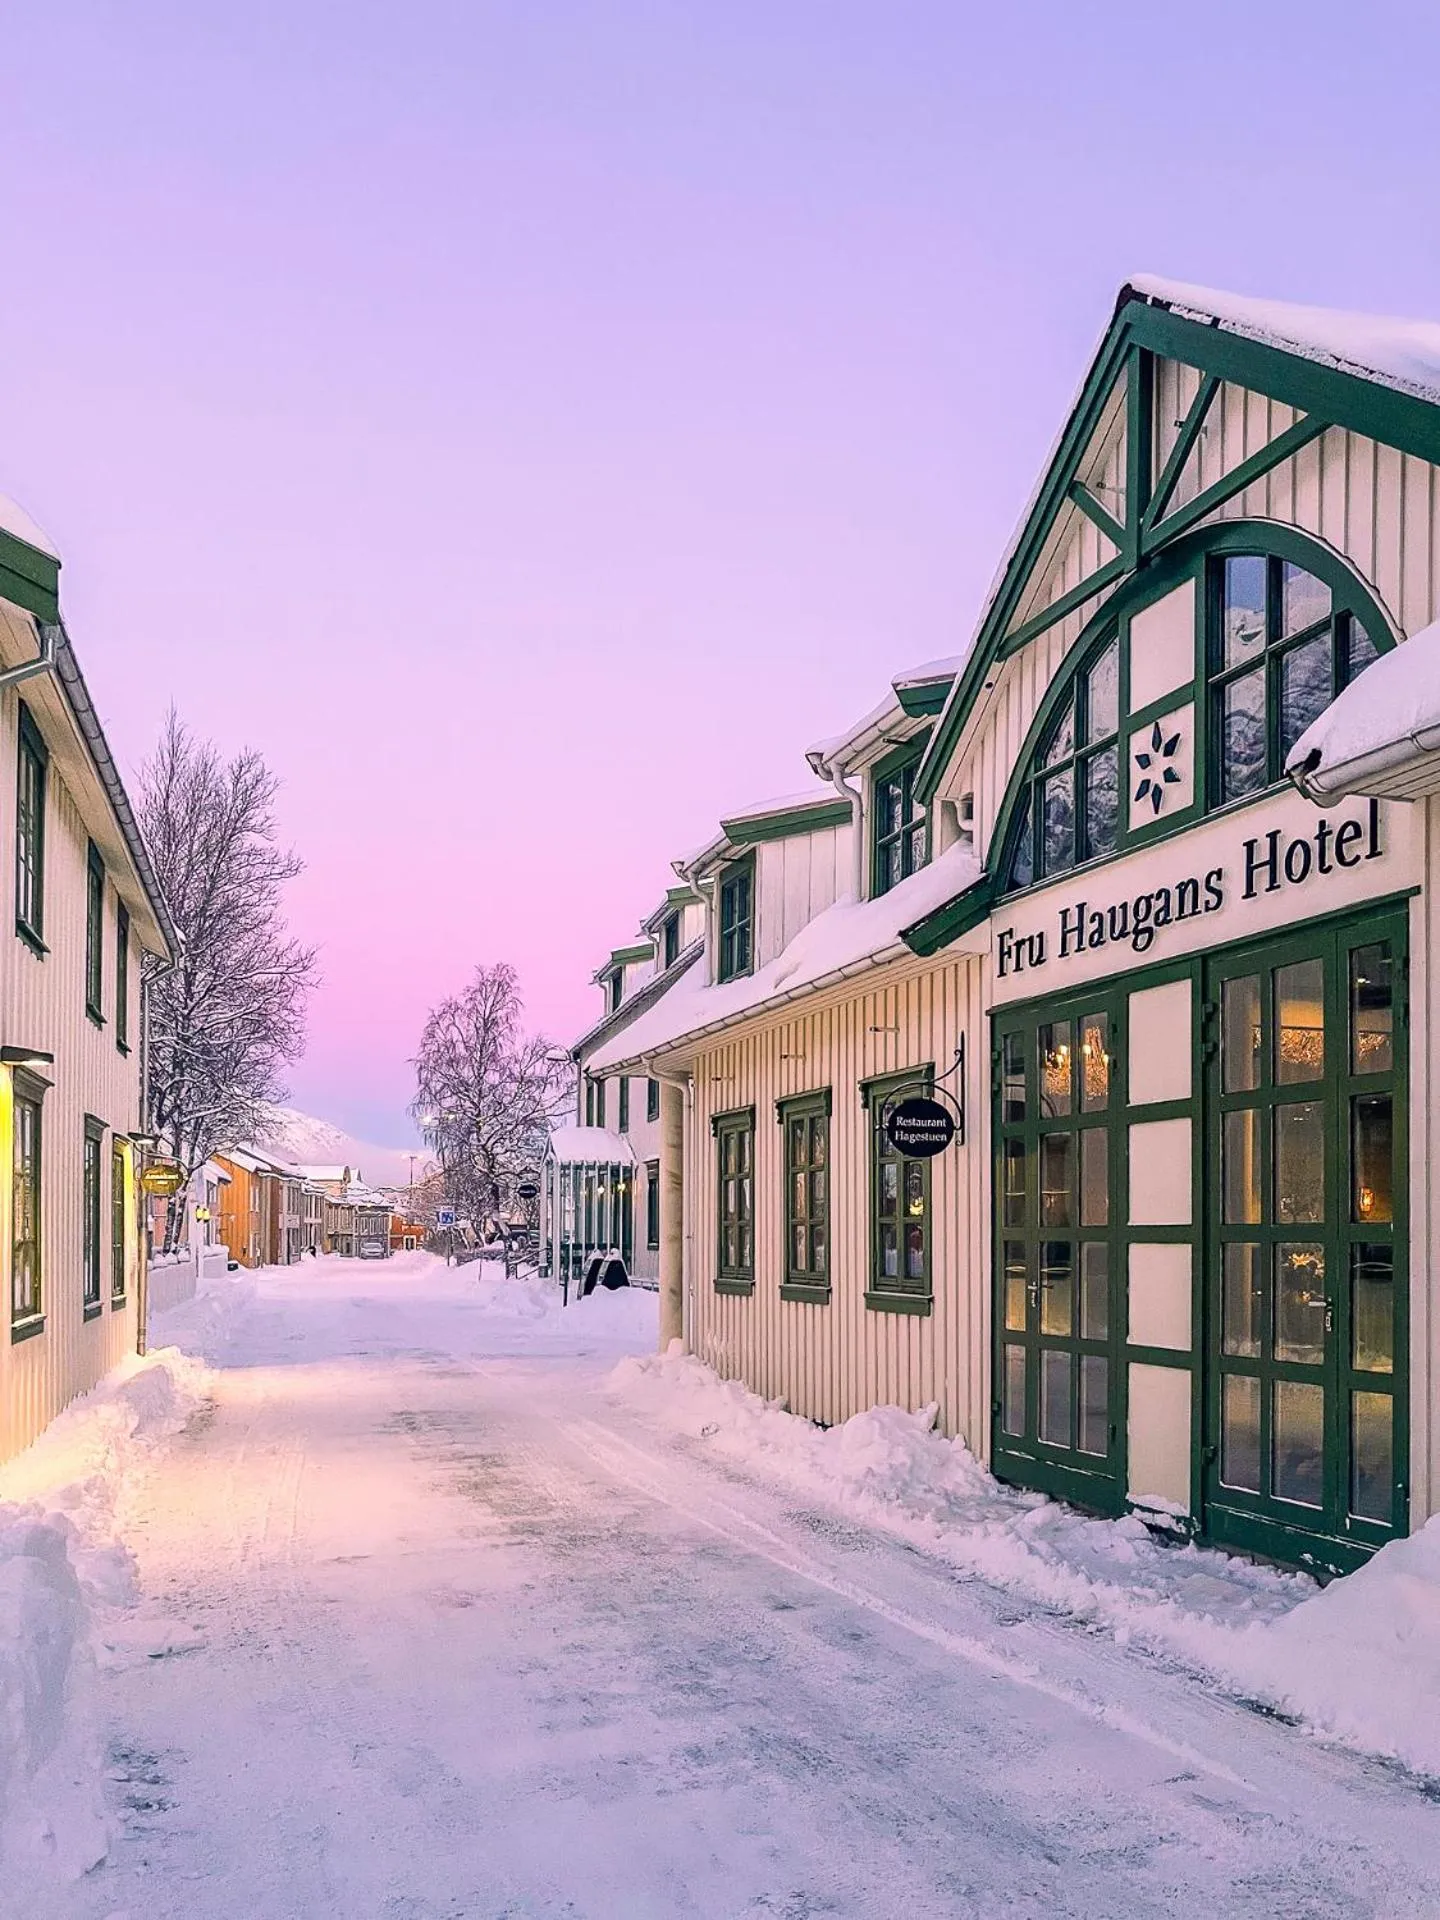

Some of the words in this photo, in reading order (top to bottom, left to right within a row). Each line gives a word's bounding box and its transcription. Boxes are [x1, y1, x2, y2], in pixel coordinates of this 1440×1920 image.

[996, 926, 1047, 978] Fru
[1058, 867, 1223, 957] Haugans
[1241, 798, 1383, 899] Hotel
[896, 1116, 946, 1127] Restaurant
[895, 1130, 947, 1143] Hagestuen
